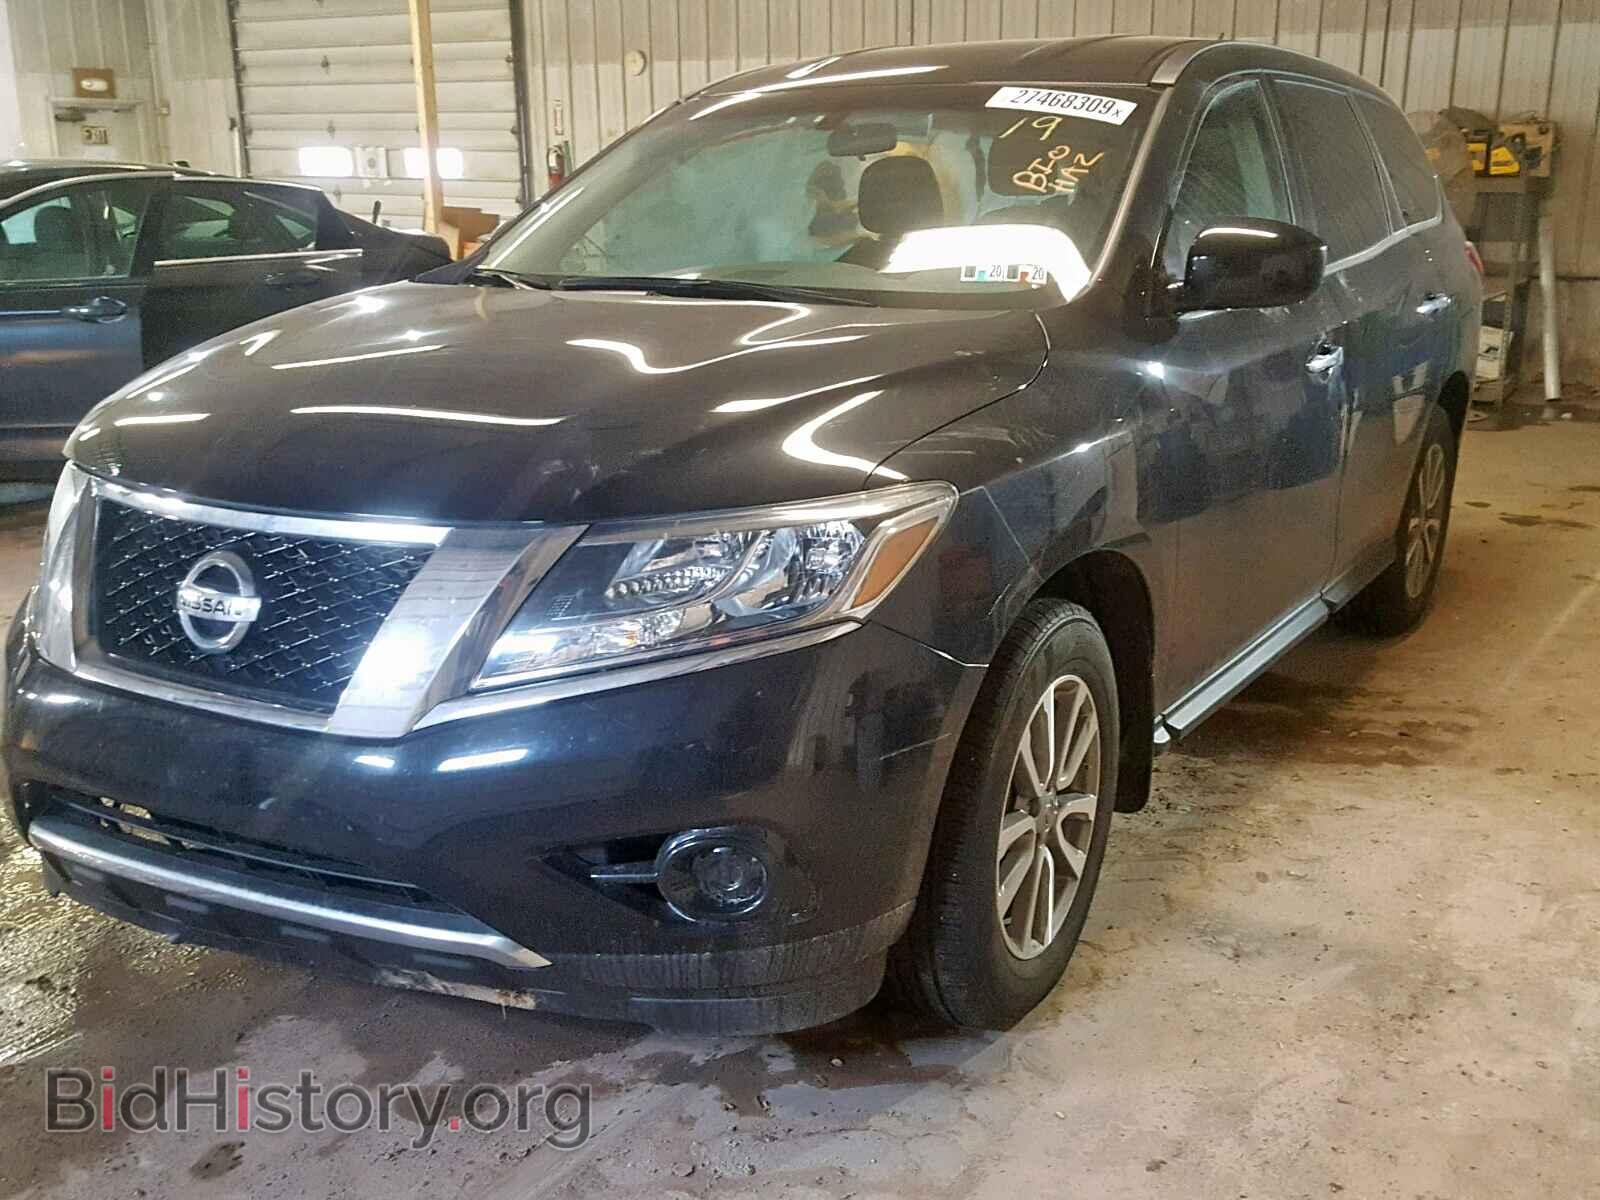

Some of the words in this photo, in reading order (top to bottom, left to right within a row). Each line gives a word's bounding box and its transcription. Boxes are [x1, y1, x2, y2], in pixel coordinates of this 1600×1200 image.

[998, 115, 1063, 141] 19
[1012, 145, 1071, 193] BIO
[180, 594, 242, 616] NISSA
